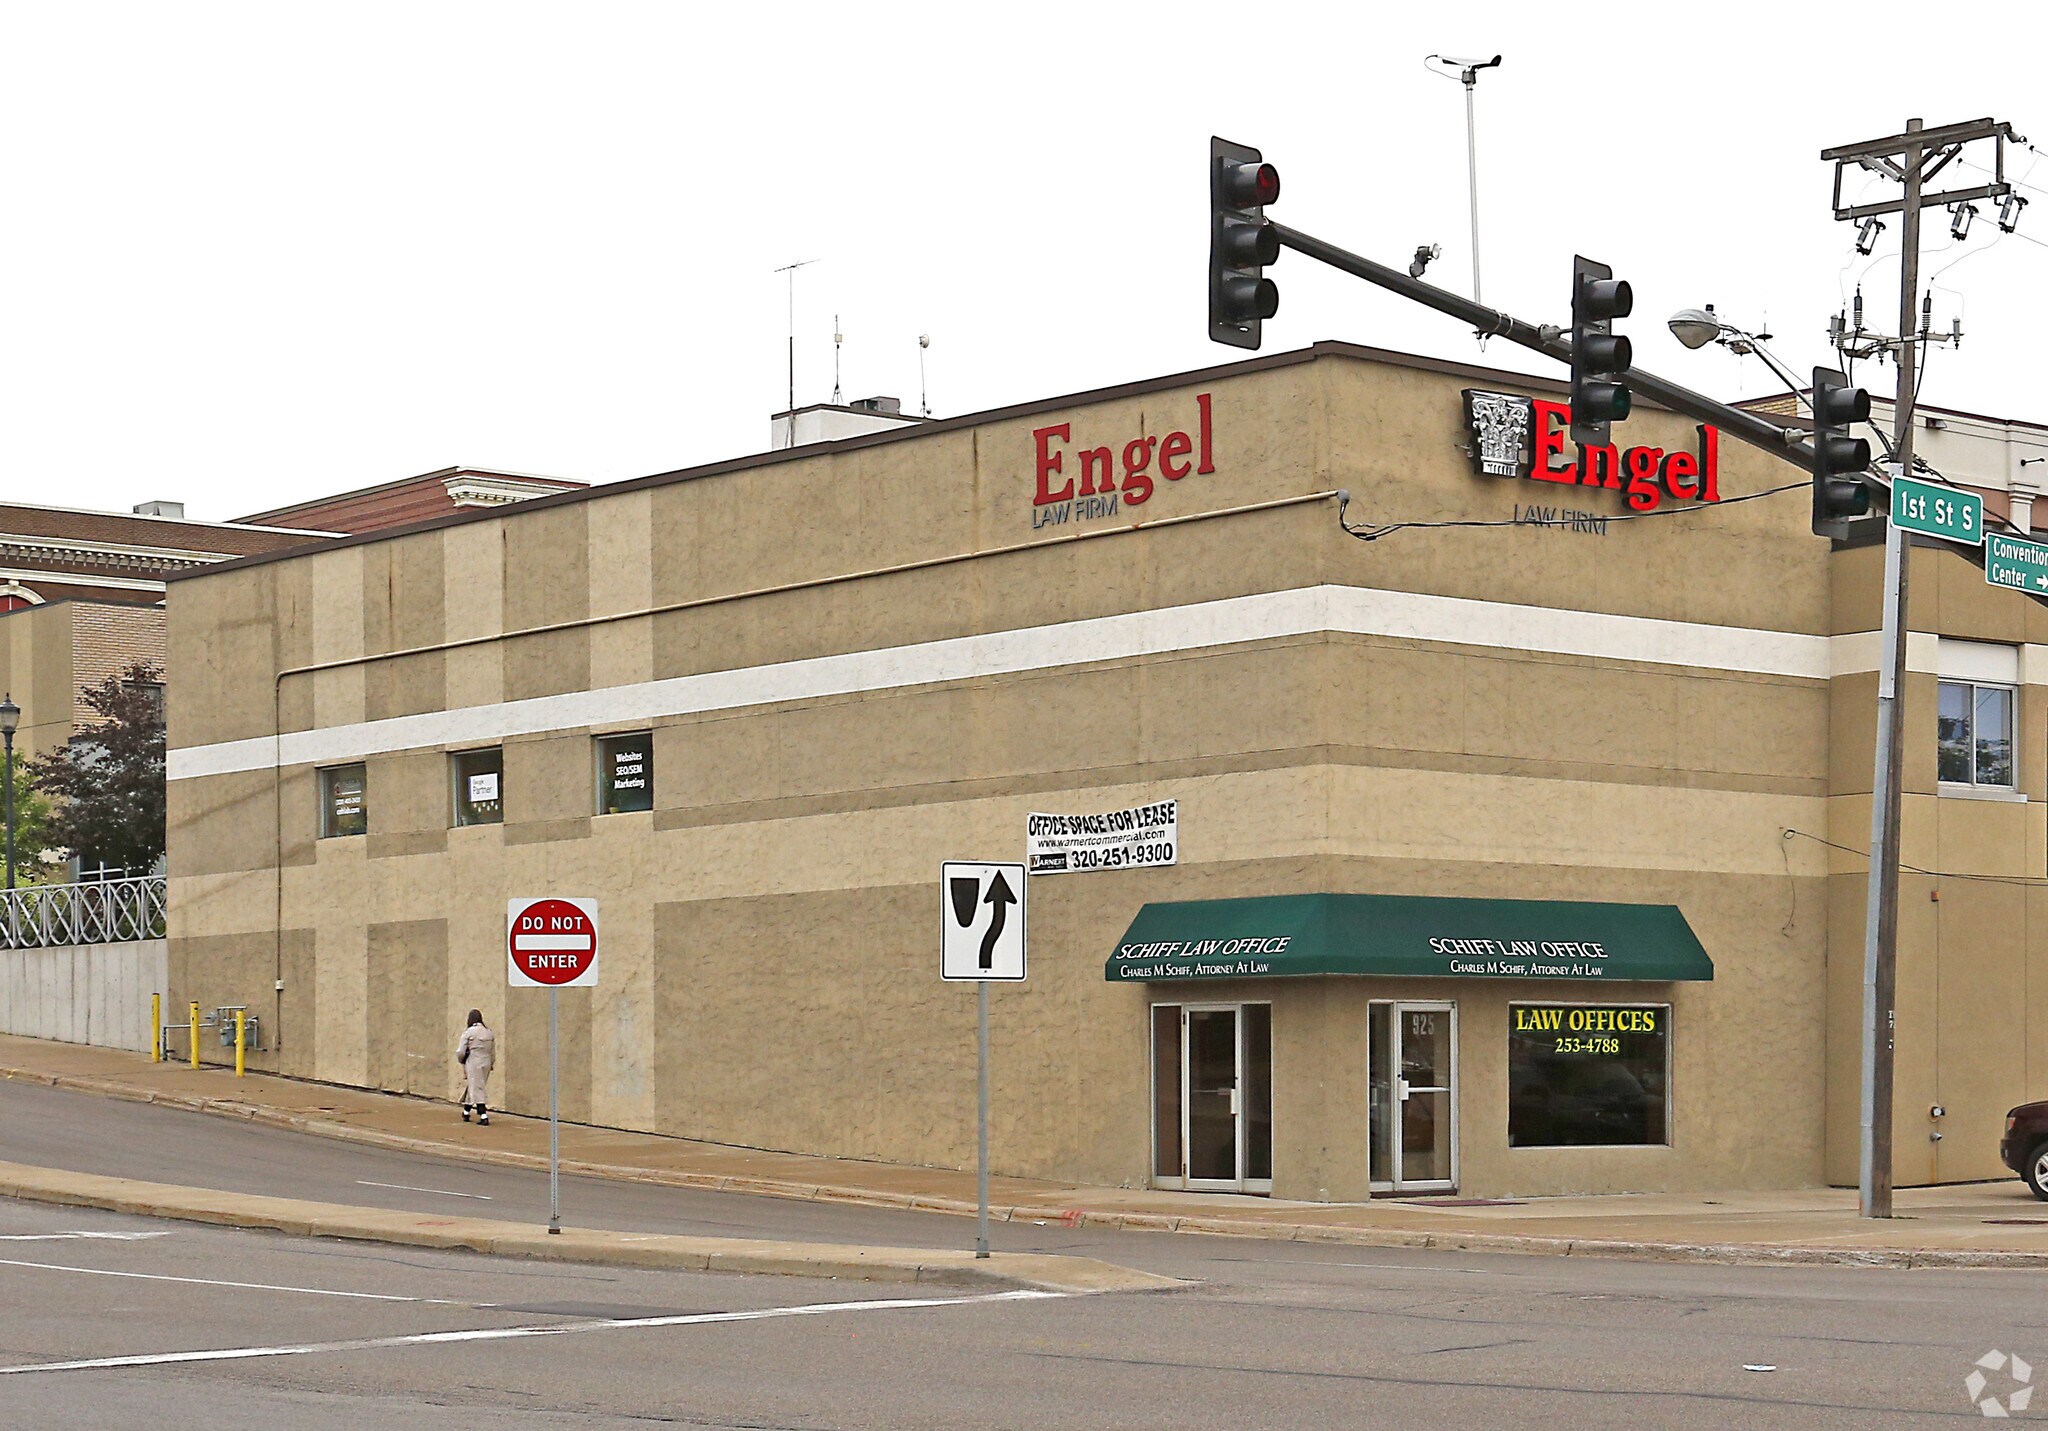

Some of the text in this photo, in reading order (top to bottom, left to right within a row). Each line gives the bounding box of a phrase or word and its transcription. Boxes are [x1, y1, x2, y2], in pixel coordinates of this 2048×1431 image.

[1033, 393, 1215, 506] Engel
[1529, 399, 1720, 511] Engel
[1033, 494, 1118, 529] LAW FIRM
[1513, 504, 1607, 536] LAW FIRM
[1901, 491, 1973, 531] 1st St S
[1992, 563, 2027, 587] Center
[614, 777, 645, 789] Marketing
[1028, 803, 1176, 836] OFFICE SPACE FOR LEASE
[1038, 829, 1165, 848] www.warnertcommercial.com
[1072, 842, 1174, 869] 320-251-9300
[522, 916, 583, 930] DO NOT
[1115, 936, 1292, 960] SCHIFF LAW OFFICE
[1428, 937, 1609, 958] SCHIFF LAW OFFICE
[528, 954, 578, 968] ENTER
[1153, 965, 1164, 976] M
[1486, 962, 1498, 973] M
[1412, 1014, 1435, 1035] 925
[1516, 1009, 1655, 1032] LAW OFFICES
[1555, 1038, 1619, 1053] 253-4788
